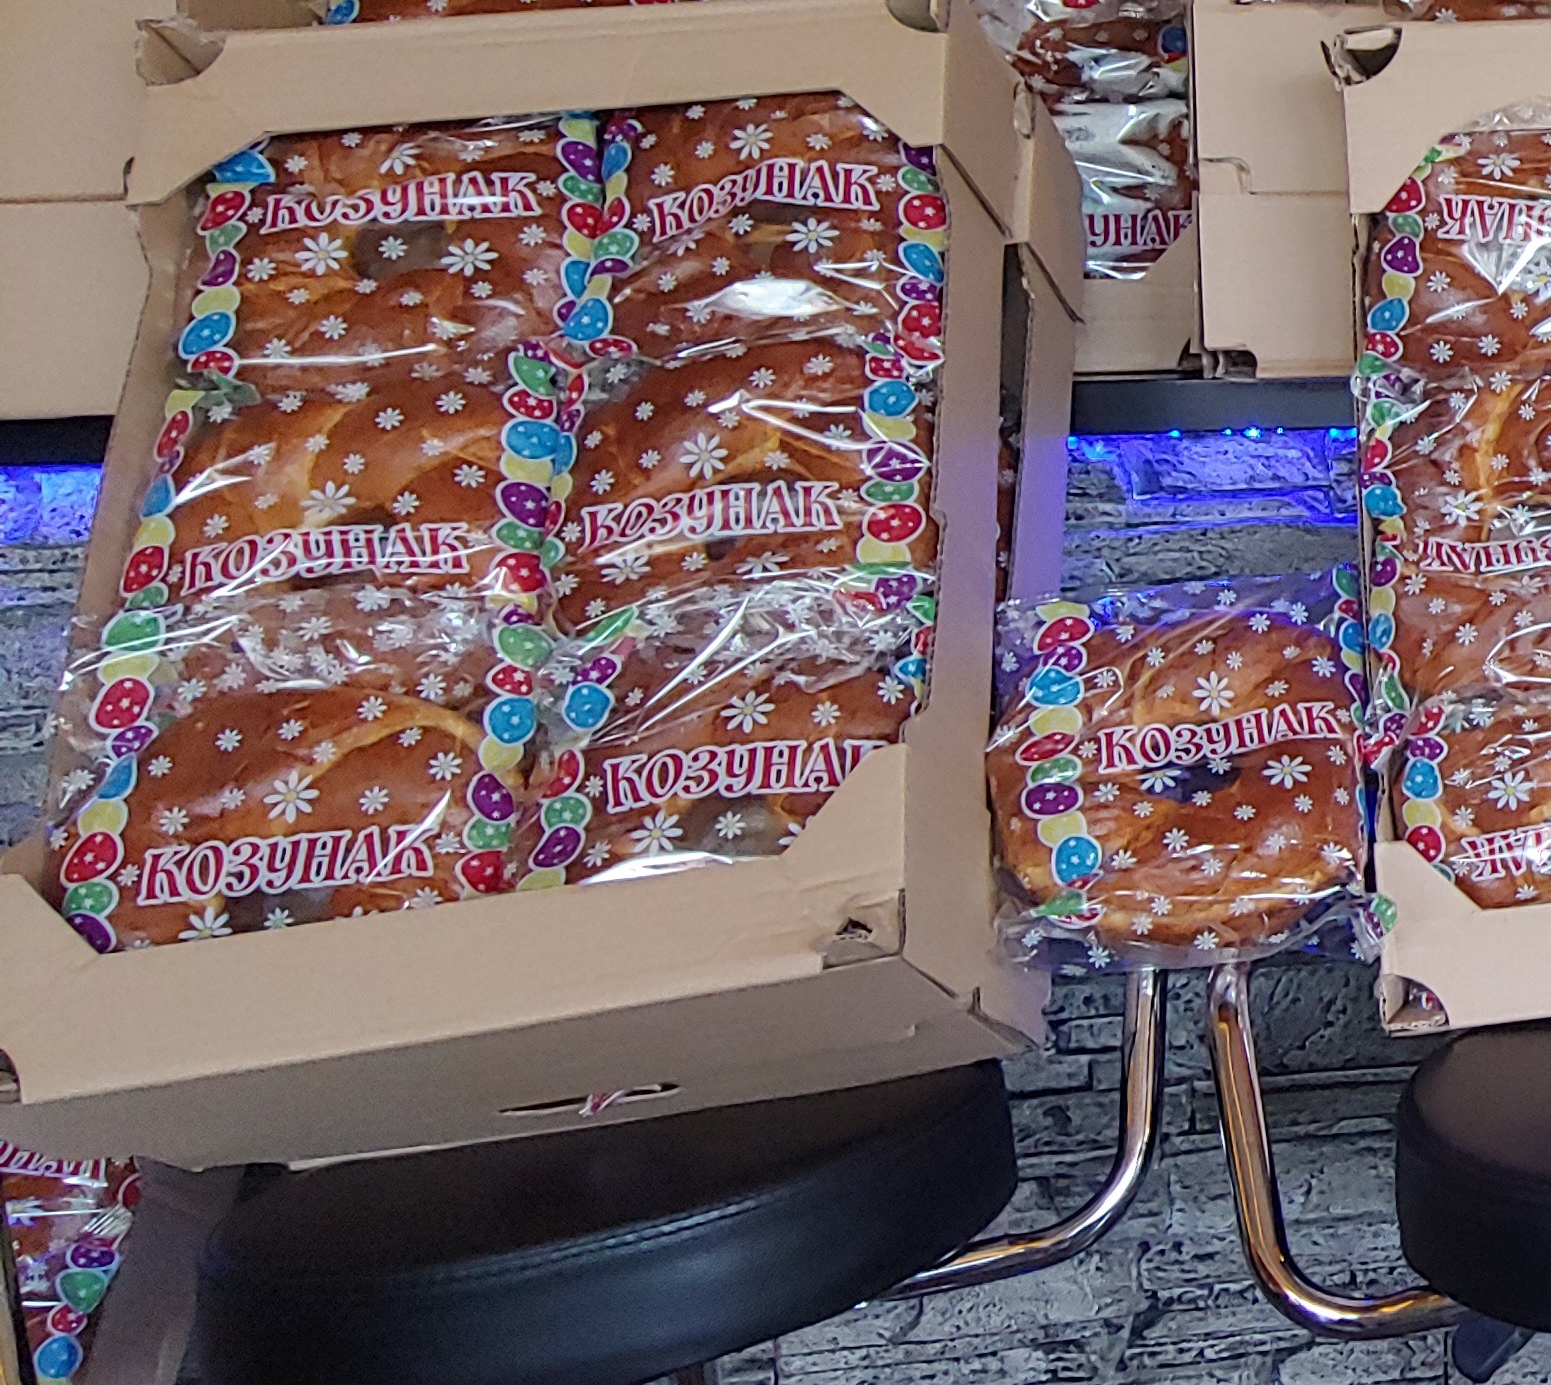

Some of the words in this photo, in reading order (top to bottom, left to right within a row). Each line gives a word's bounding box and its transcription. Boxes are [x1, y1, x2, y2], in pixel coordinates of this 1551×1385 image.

[259, 172, 542, 233] КОЗУНАК
[649, 159, 879, 243] КОЗУНАК
[1085, 209, 1192, 249] УНАК
[579, 481, 841, 552] КОЗУНАК
[182, 523, 470, 596] КОЗУНАК
[1098, 701, 1340, 775] КОЗУНАК
[137, 825, 434, 906] КОЗУНАК
